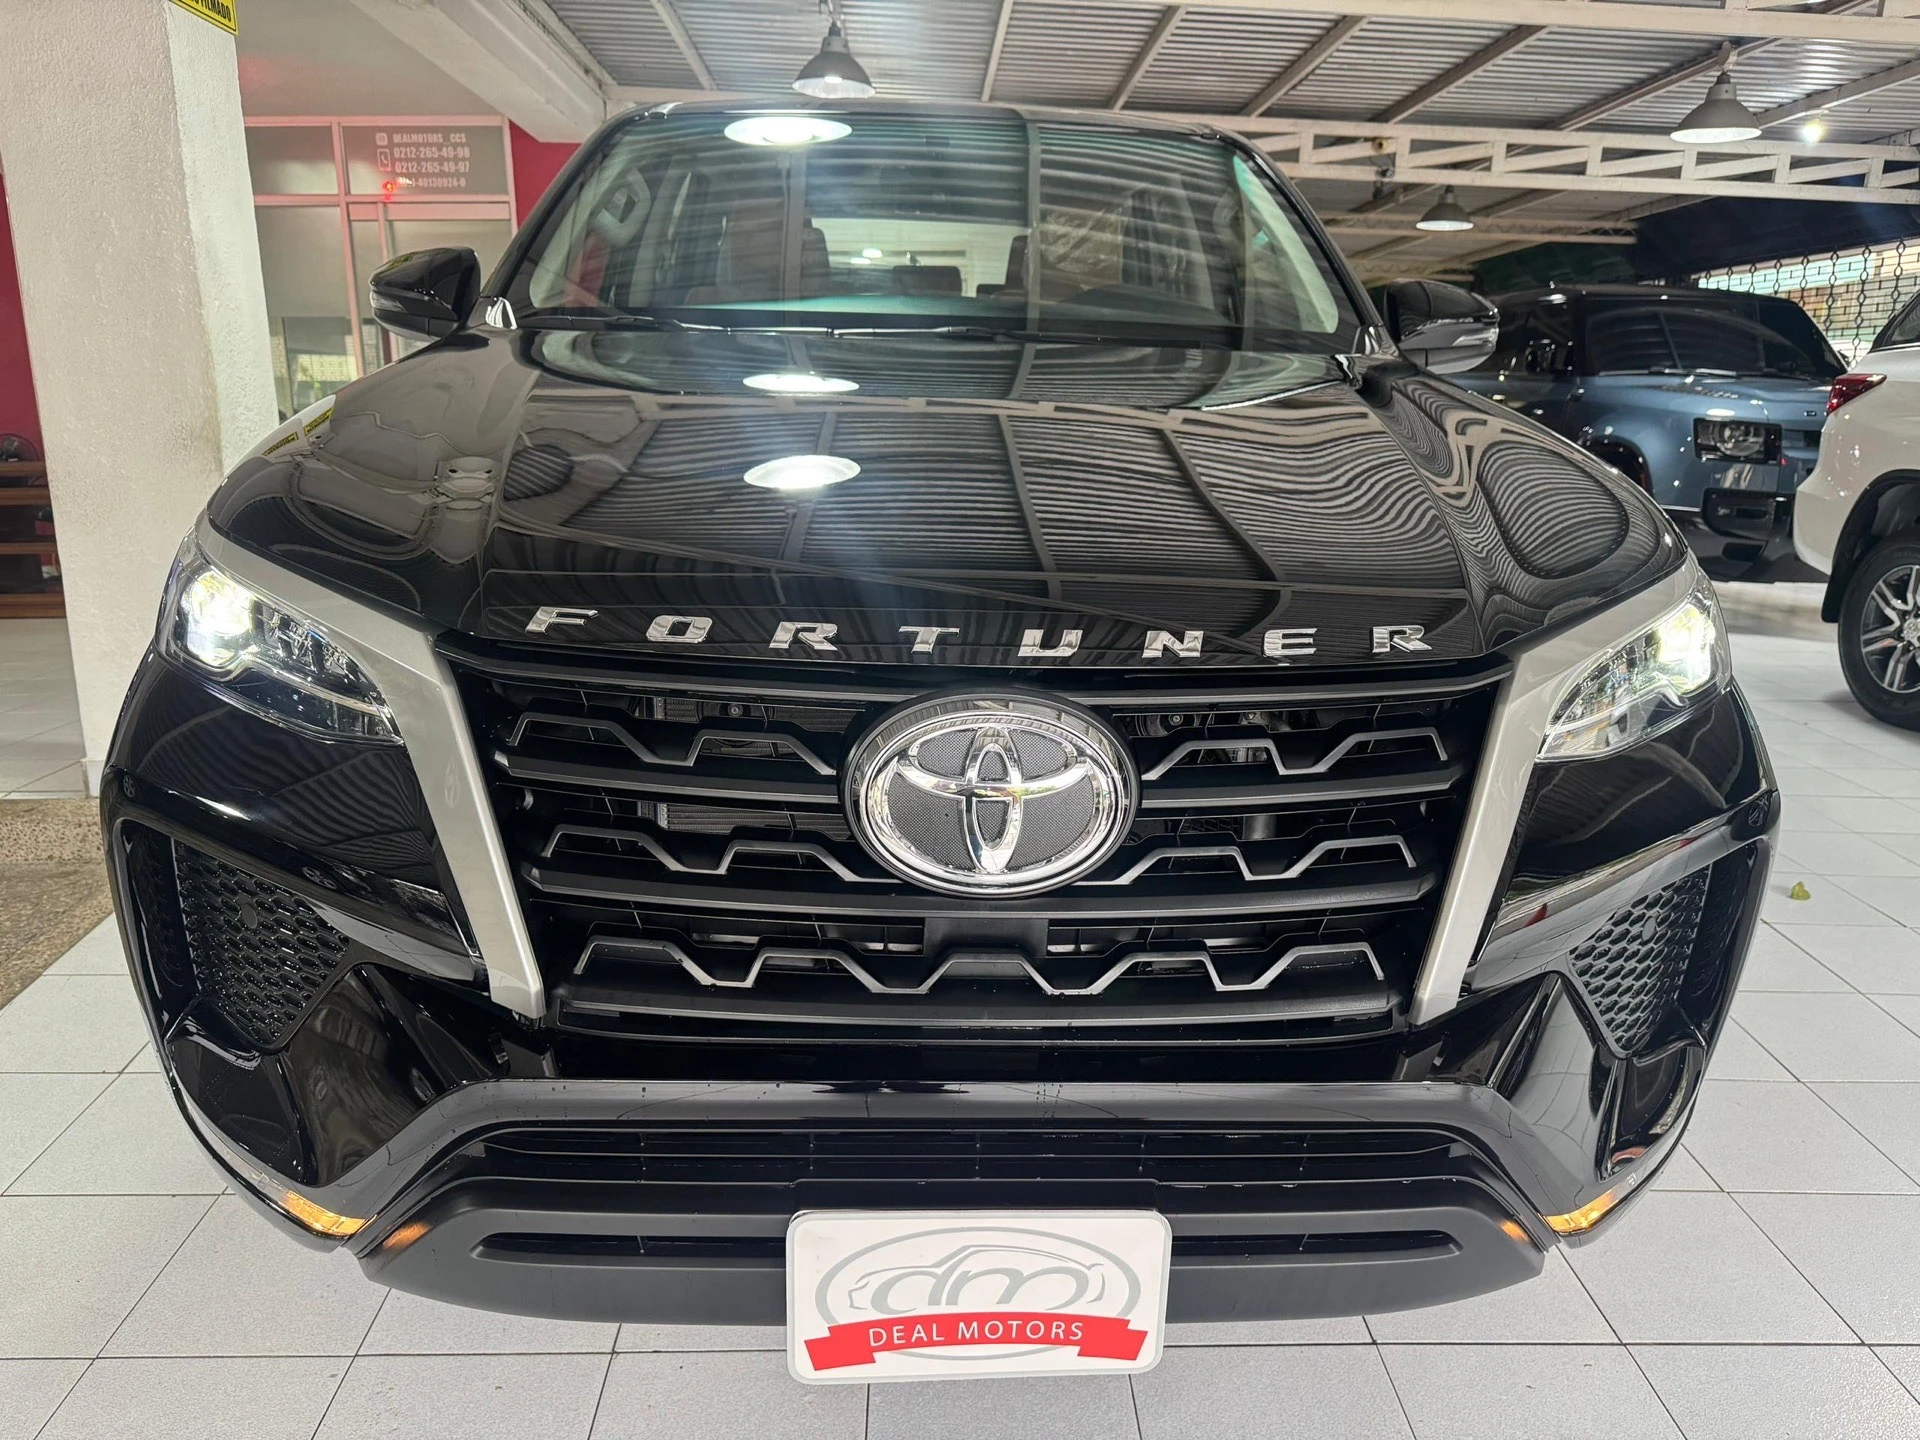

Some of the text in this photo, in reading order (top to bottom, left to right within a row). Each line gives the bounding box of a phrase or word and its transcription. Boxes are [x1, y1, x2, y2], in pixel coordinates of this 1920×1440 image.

[393, 146, 470, 158] 0212-265-49-98
[395, 161, 470, 173] 0212-265-49-97
[525, 606, 1432, 658] FORTUNER
[868, 1320, 1084, 1347] DEAL MOTORS
